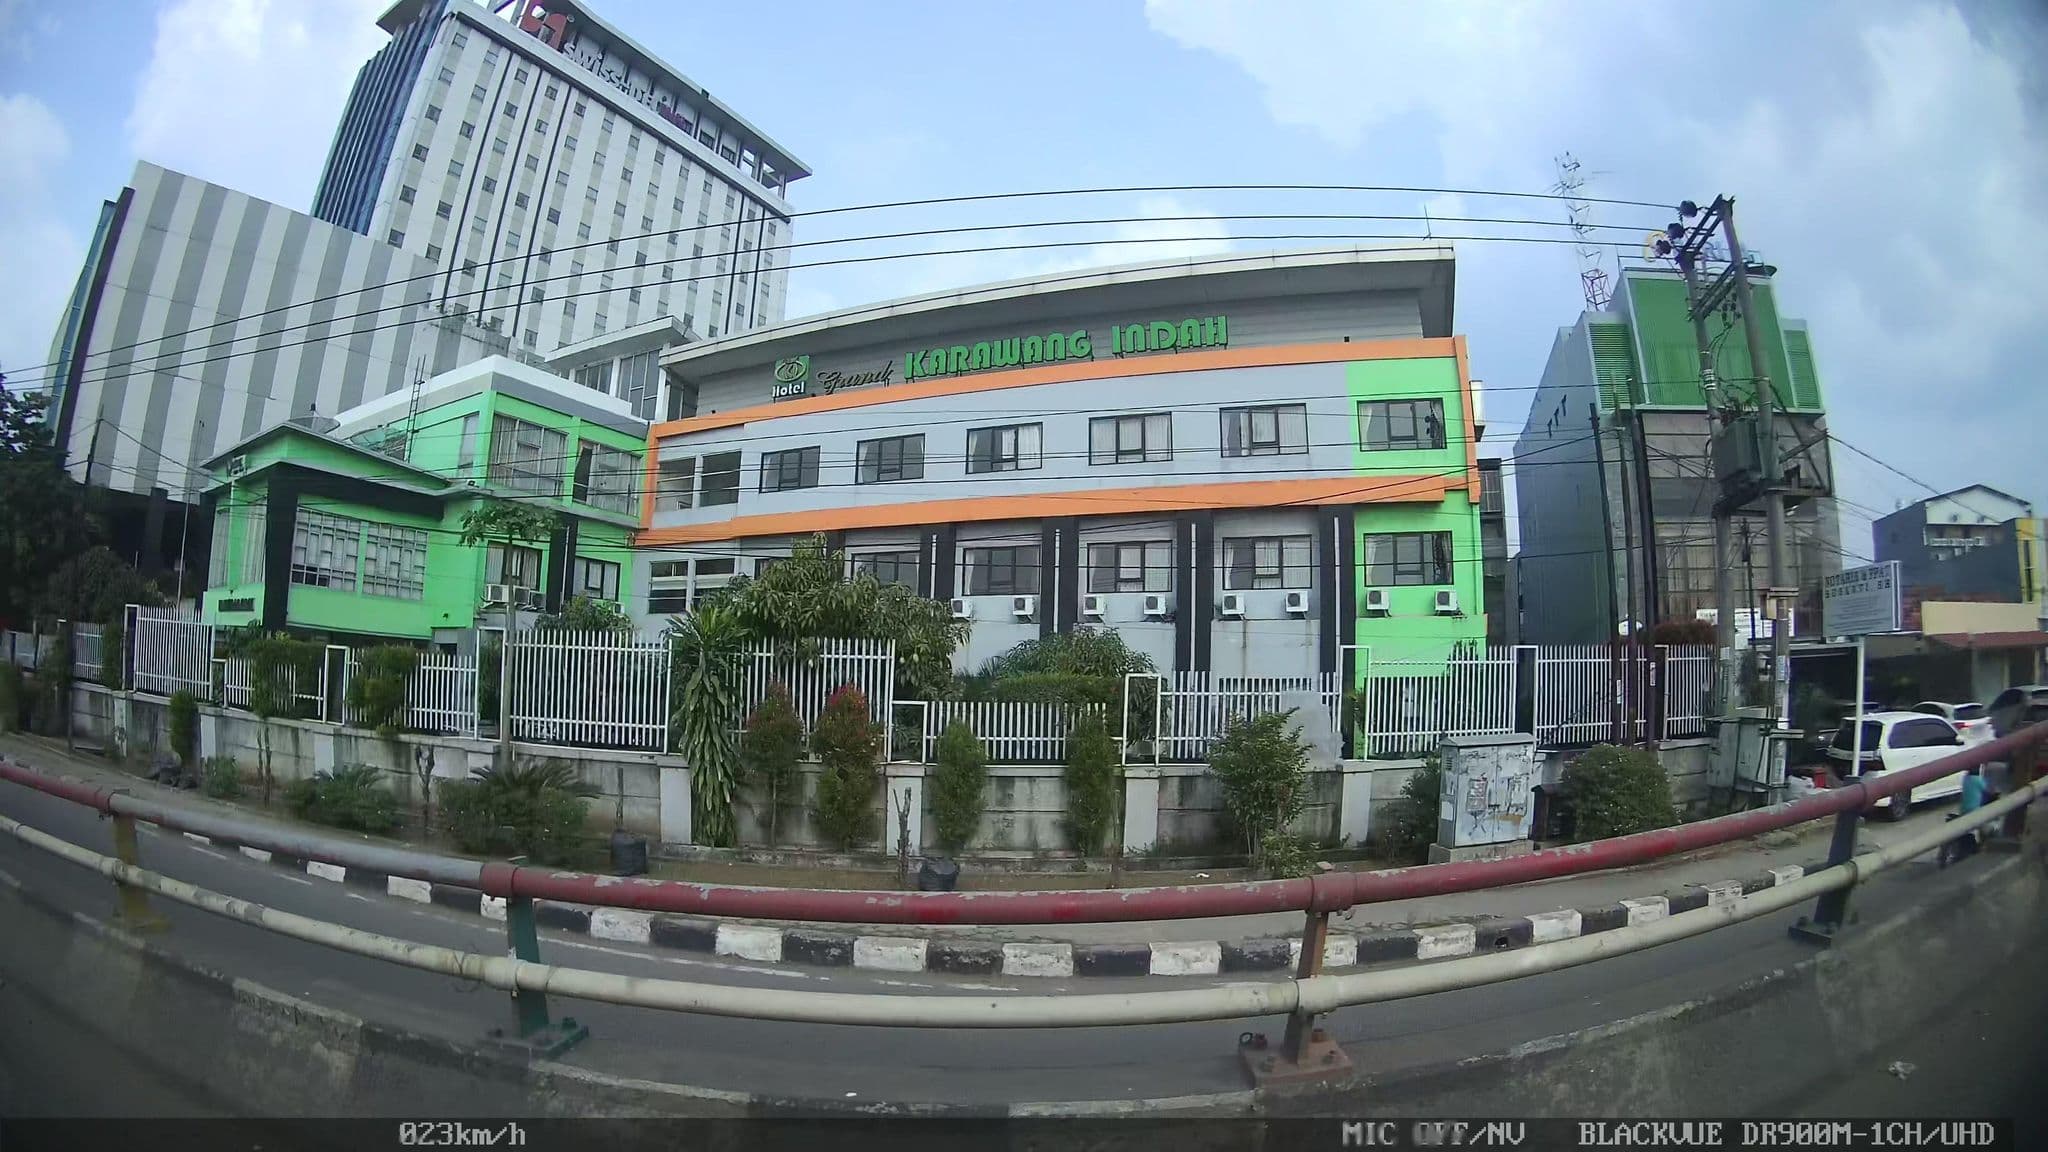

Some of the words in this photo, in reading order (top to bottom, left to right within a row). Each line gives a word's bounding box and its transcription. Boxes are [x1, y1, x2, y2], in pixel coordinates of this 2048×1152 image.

[816, 360, 894, 395] Grand
[904, 330, 1092, 379] KARAWANG
[1111, 315, 1227, 354] INDAH
[772, 382, 805, 397] Hotel
